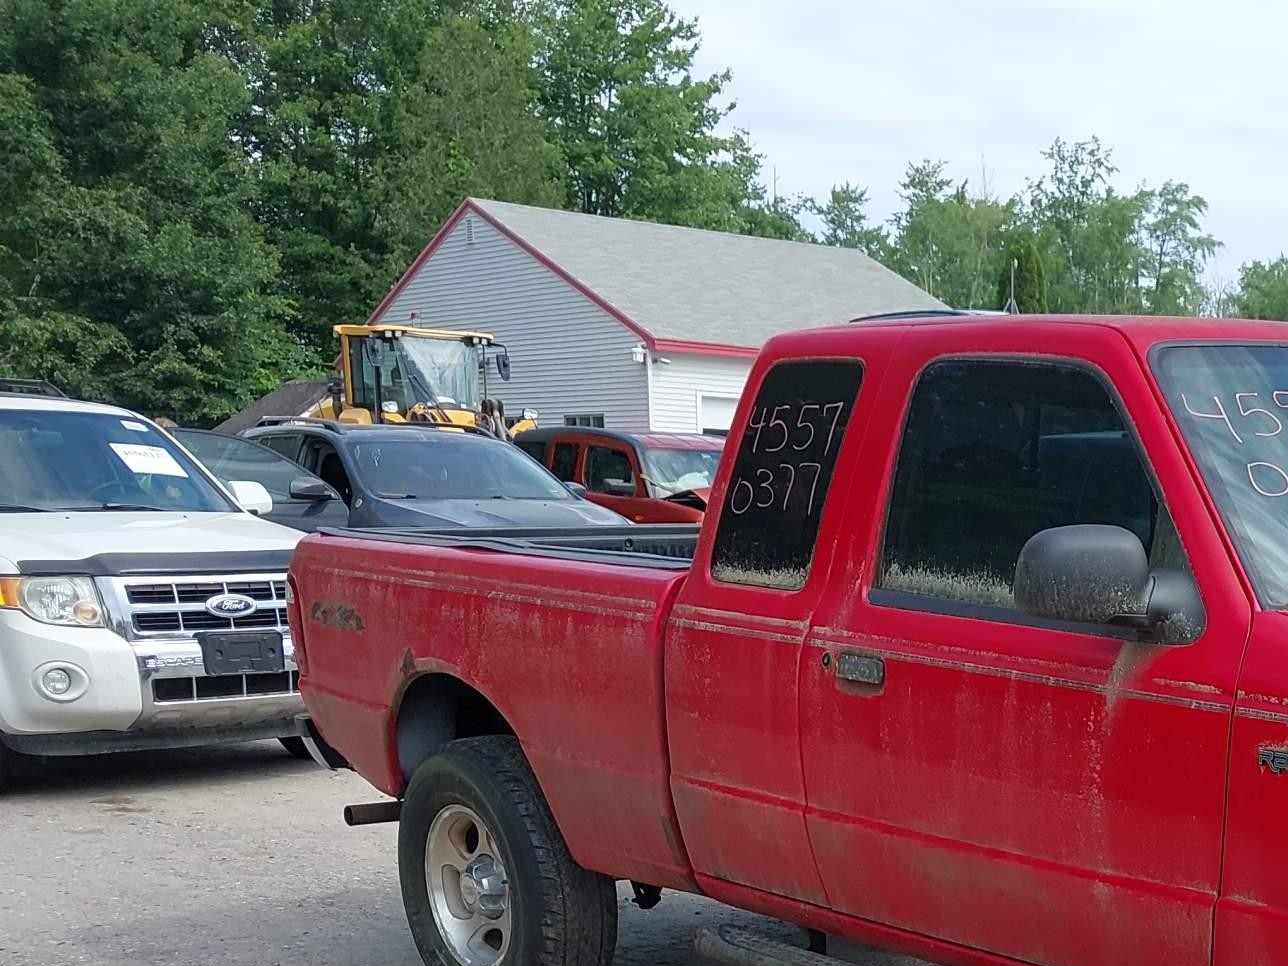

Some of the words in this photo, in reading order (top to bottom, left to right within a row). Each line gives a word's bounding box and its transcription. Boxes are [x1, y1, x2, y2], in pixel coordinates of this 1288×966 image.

[749, 401, 844, 457] 4557
[731, 462, 821, 516] 0377
[145, 656, 204, 668] ESCAPE
